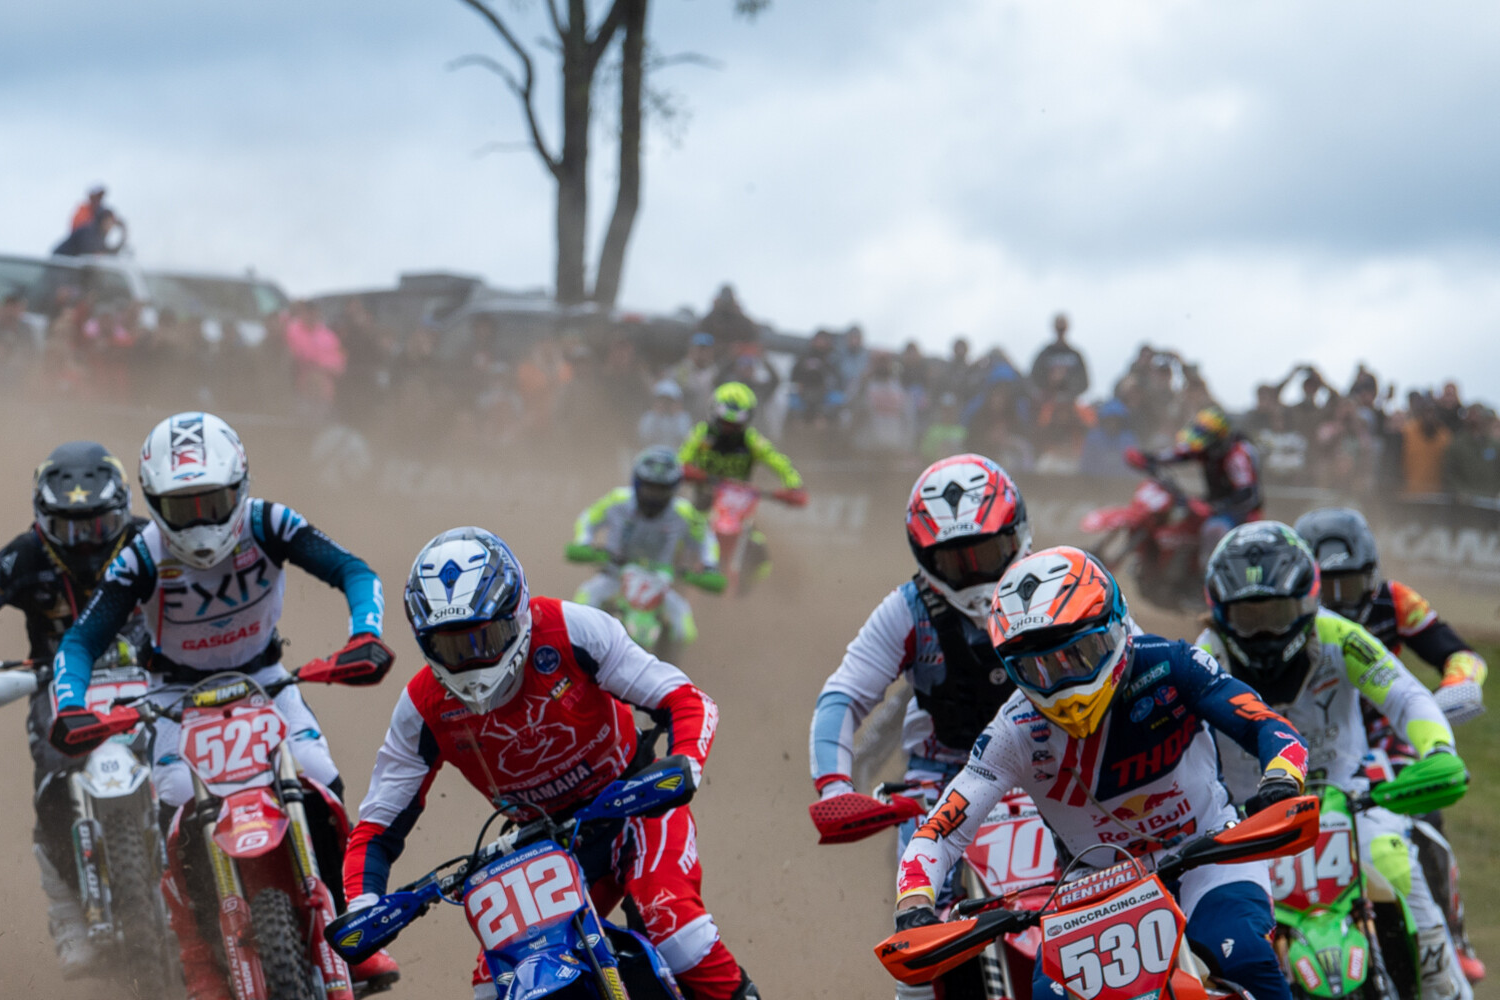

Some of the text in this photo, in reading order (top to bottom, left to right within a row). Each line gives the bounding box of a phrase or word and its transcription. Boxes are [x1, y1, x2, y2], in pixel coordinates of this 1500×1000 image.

[943, 524, 974, 536] SHOEI
[164, 556, 271, 616] FXR
[434, 606, 466, 621] SHOEI
[1011, 617, 1044, 632] SHOEI
[182, 622, 260, 650] GASGAS
[1132, 666, 1166, 692] MOTOREX
[195, 714, 281, 780] 523
[516, 764, 591, 802] YAMAHA
[1099, 799, 1192, 846] Red Bull
[1286, 800, 1316, 819] KTM
[78, 824, 100, 900] DULOP
[1058, 862, 1133, 895] RENTHAL
[1269, 831, 1353, 899] 314
[468, 854, 582, 950] 212
[1061, 871, 1137, 907] RENTHAL
[319, 940, 333, 974] MOTUL
[881, 940, 910, 957] KTM
[1060, 907, 1178, 1000] 530
